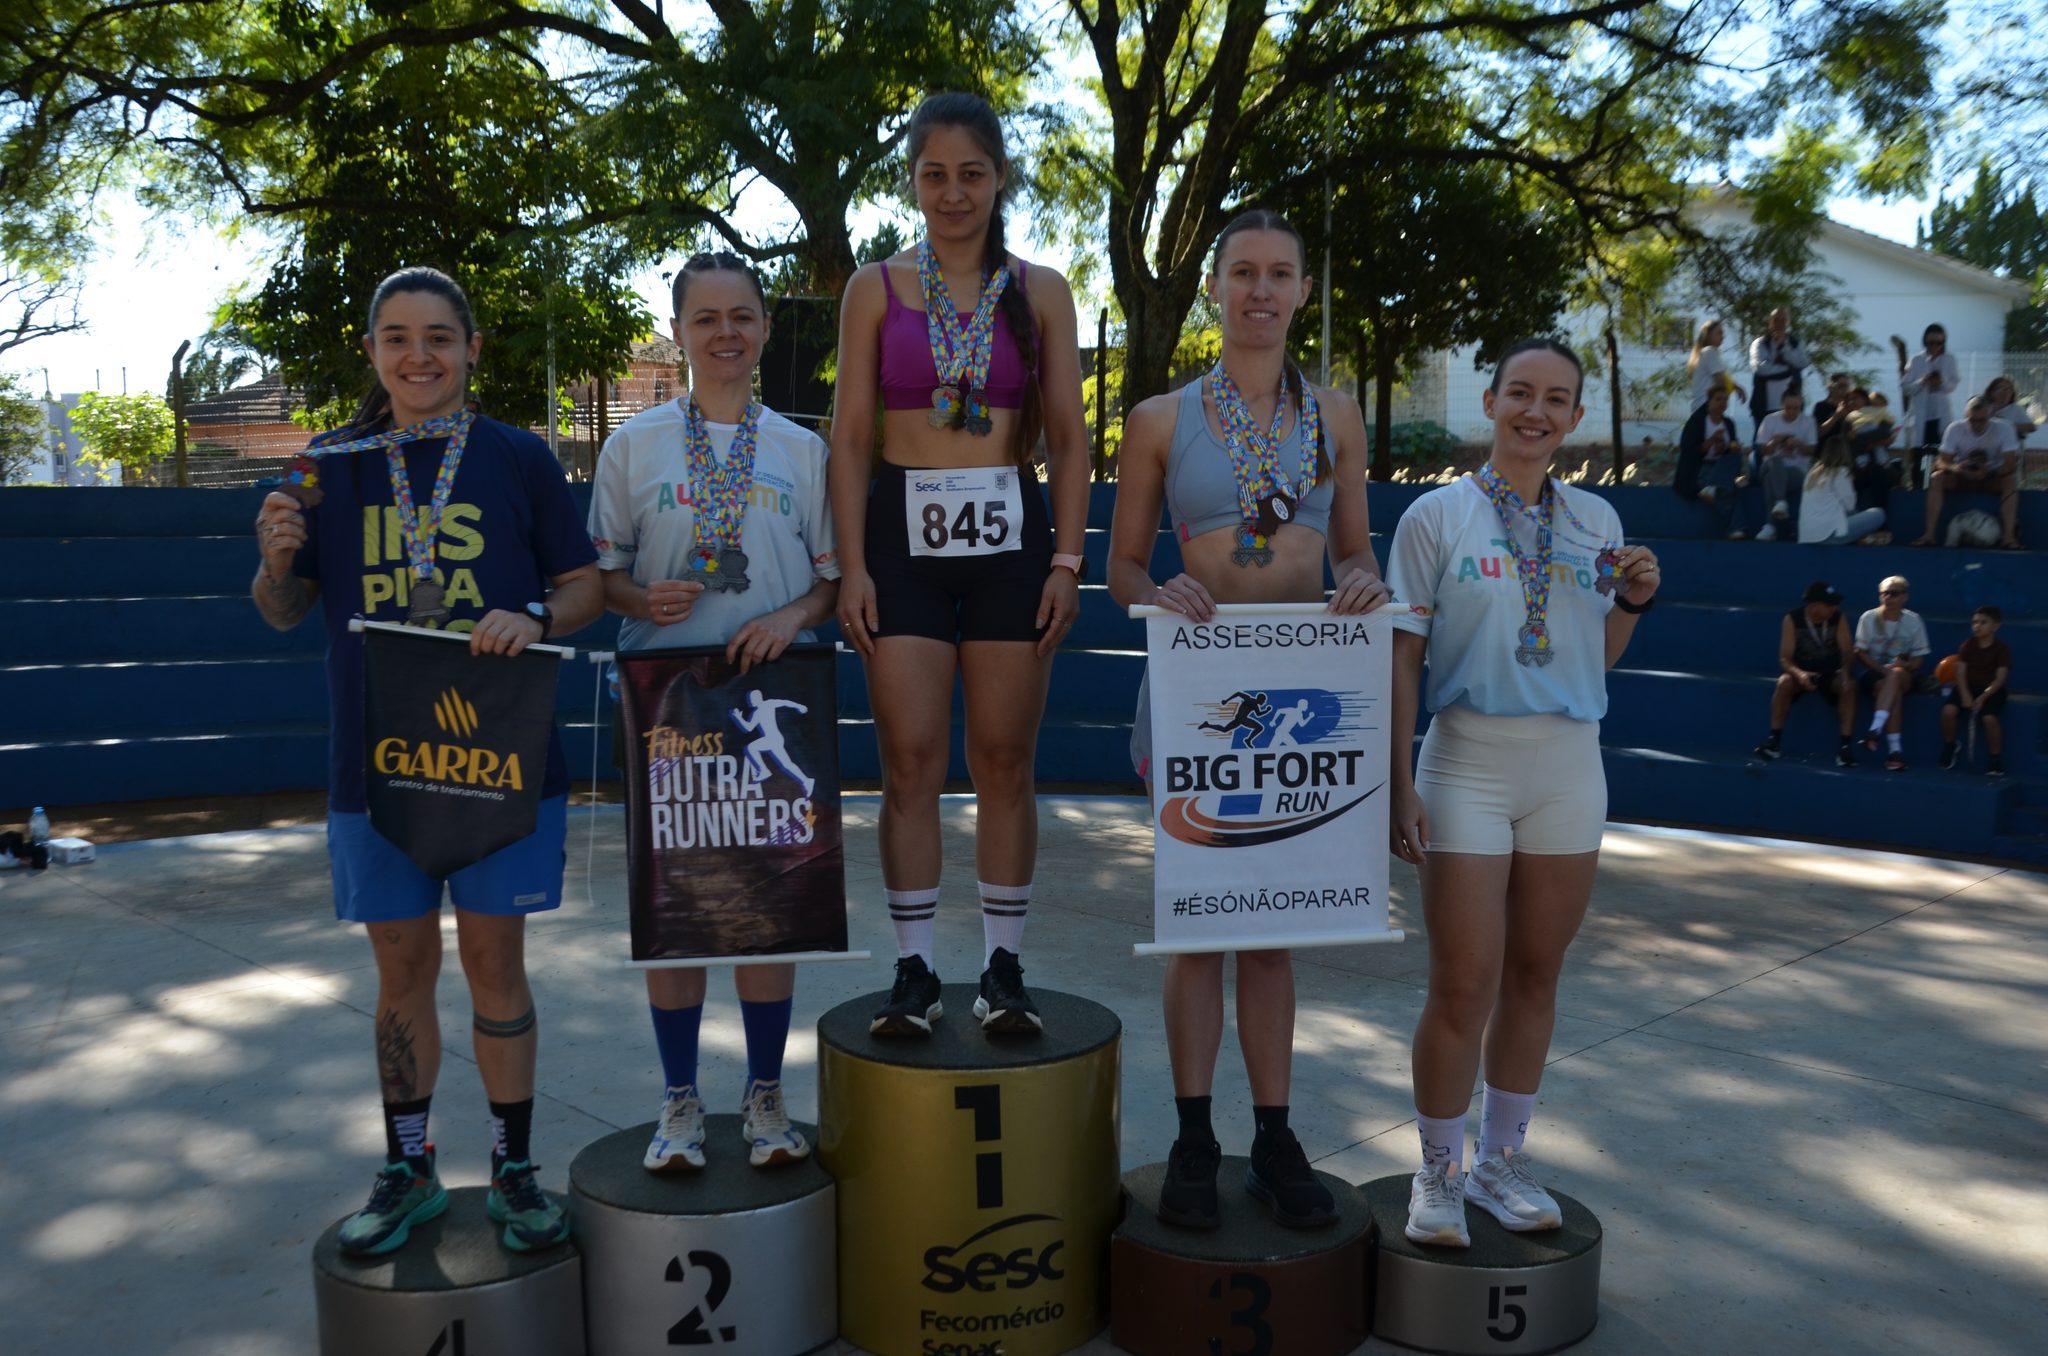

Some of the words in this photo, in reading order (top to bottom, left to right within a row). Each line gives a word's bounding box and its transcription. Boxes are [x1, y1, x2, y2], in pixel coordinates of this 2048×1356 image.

[658, 482, 791, 516] Aumo
[922, 500, 1009, 549] 845
[1458, 555, 1592, 589] Autmo
[1171, 622, 1370, 650] ASSESSORIA
[374, 737, 523, 791] GARRA
[642, 725, 724, 761] Fitness
[388, 778, 424, 791] centro
[425, 781, 440, 793] de
[440, 784, 505, 801] treinamento
[649, 754, 764, 803] DUTRA
[1166, 754, 1240, 793] BIG
[1253, 750, 1364, 789] FORT
[651, 797, 815, 850] RUNNERS
[1275, 791, 1330, 814] RUN
[1173, 887, 1370, 917] #ÉSÓNÃOPARAR
[954, 1084, 1003, 1209] 1
[665, 1250, 736, 1345] 2
[920, 1301, 1065, 1332] Fecomércio
[1208, 1273, 1274, 1356] 3
[1486, 1285, 1528, 1342] 5
